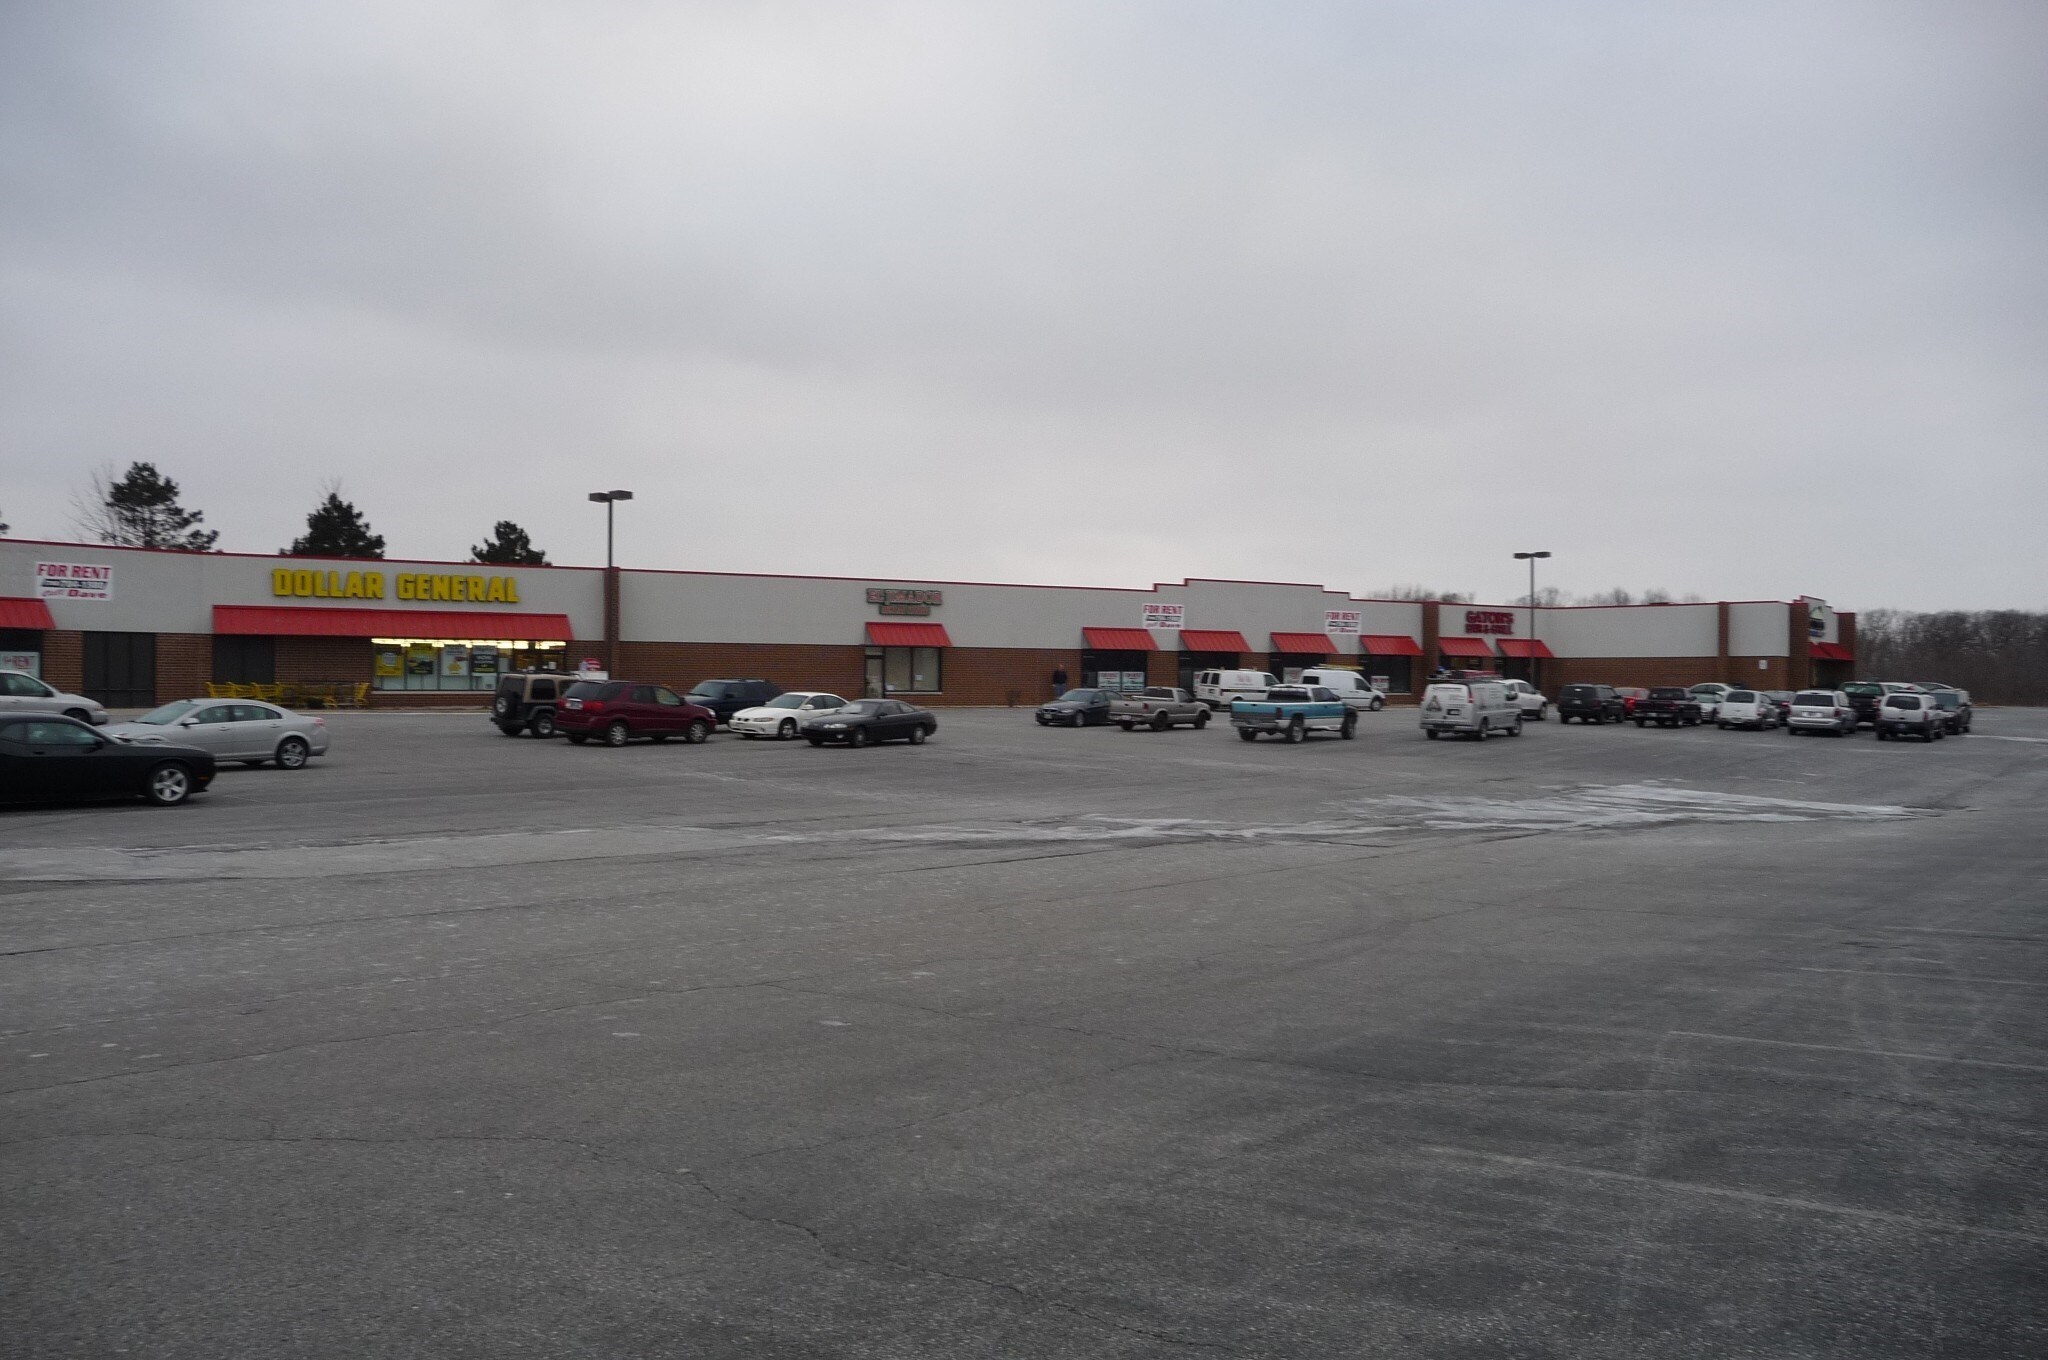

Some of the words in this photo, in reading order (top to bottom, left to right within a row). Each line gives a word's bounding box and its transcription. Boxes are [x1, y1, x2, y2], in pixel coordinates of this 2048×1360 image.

[37, 563, 67, 577] FOR
[72, 565, 112, 580] RENT
[272, 568, 385, 600] DOLLAR
[396, 572, 521, 603] GENERAL
[1143, 604, 1160, 614] FOR
[1161, 606, 1184, 615] RENT
[1326, 612, 1340, 620] FOR
[1342, 612, 1361, 621] RENT
